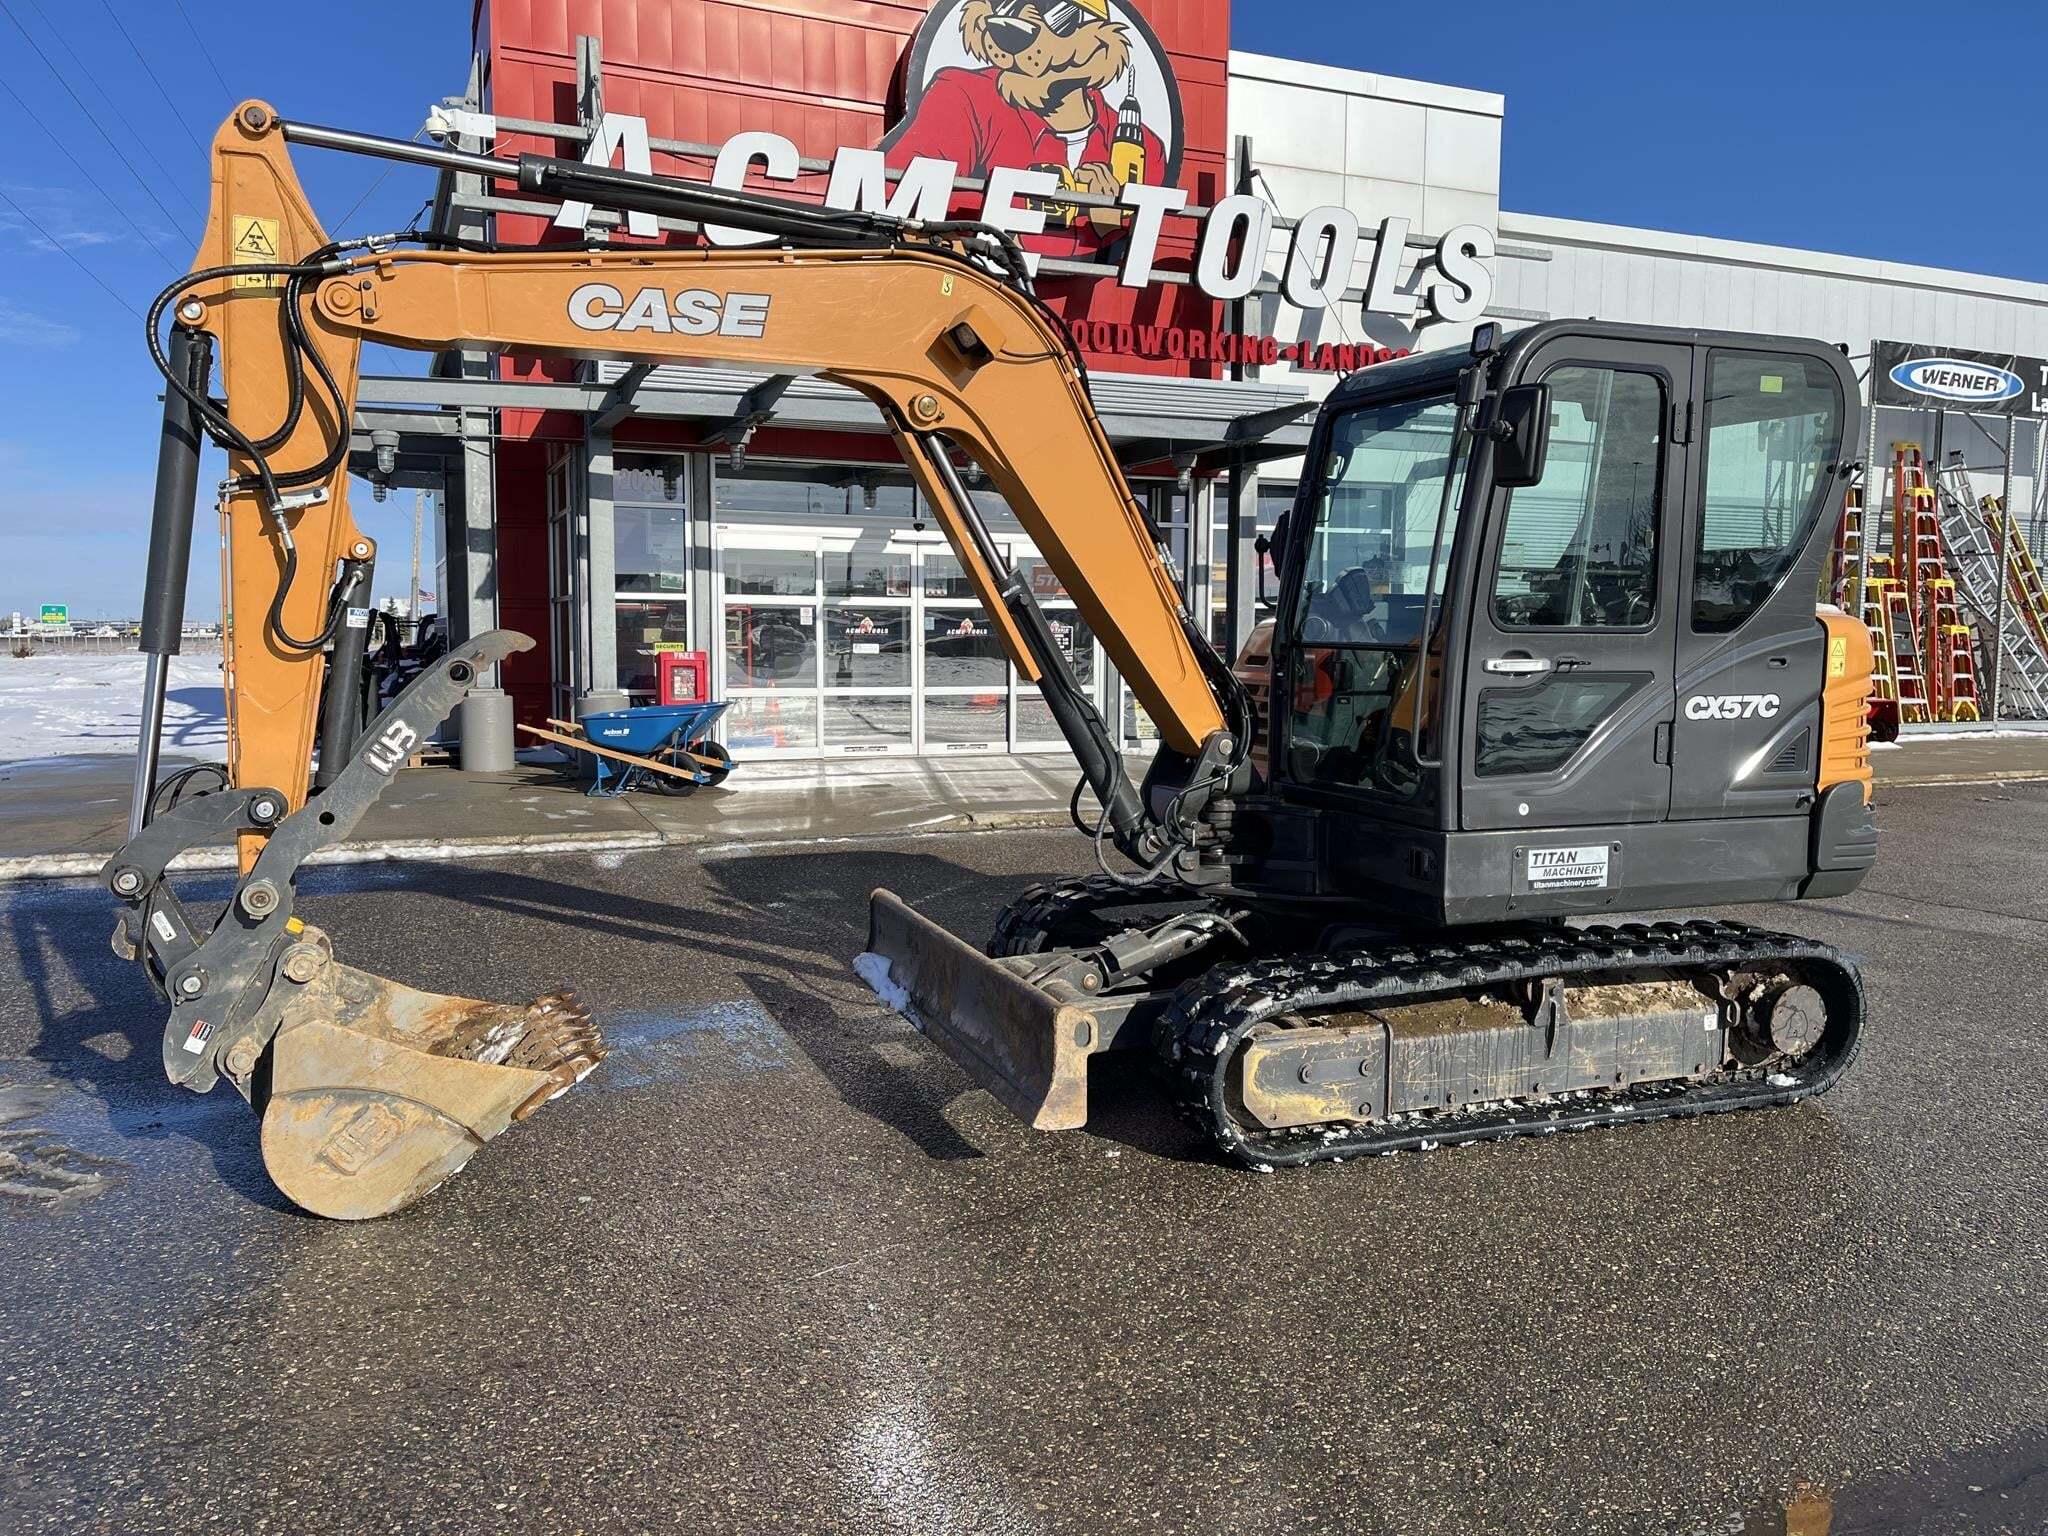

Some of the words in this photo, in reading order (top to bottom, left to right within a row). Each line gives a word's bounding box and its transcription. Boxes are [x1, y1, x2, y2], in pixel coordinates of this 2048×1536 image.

[553, 111, 1060, 278] ACME
[1119, 182, 1496, 323] TOOLS
[567, 282, 772, 338] CASE
[1921, 368, 2000, 392] WERNER
[673, 652, 696, 660] FREE
[1684, 693, 1781, 720] CX57C
[1532, 851, 1578, 866] TITAN
[1542, 864, 1605, 878] MACHINERY
[1533, 877, 1604, 890] titanmachinery.com
